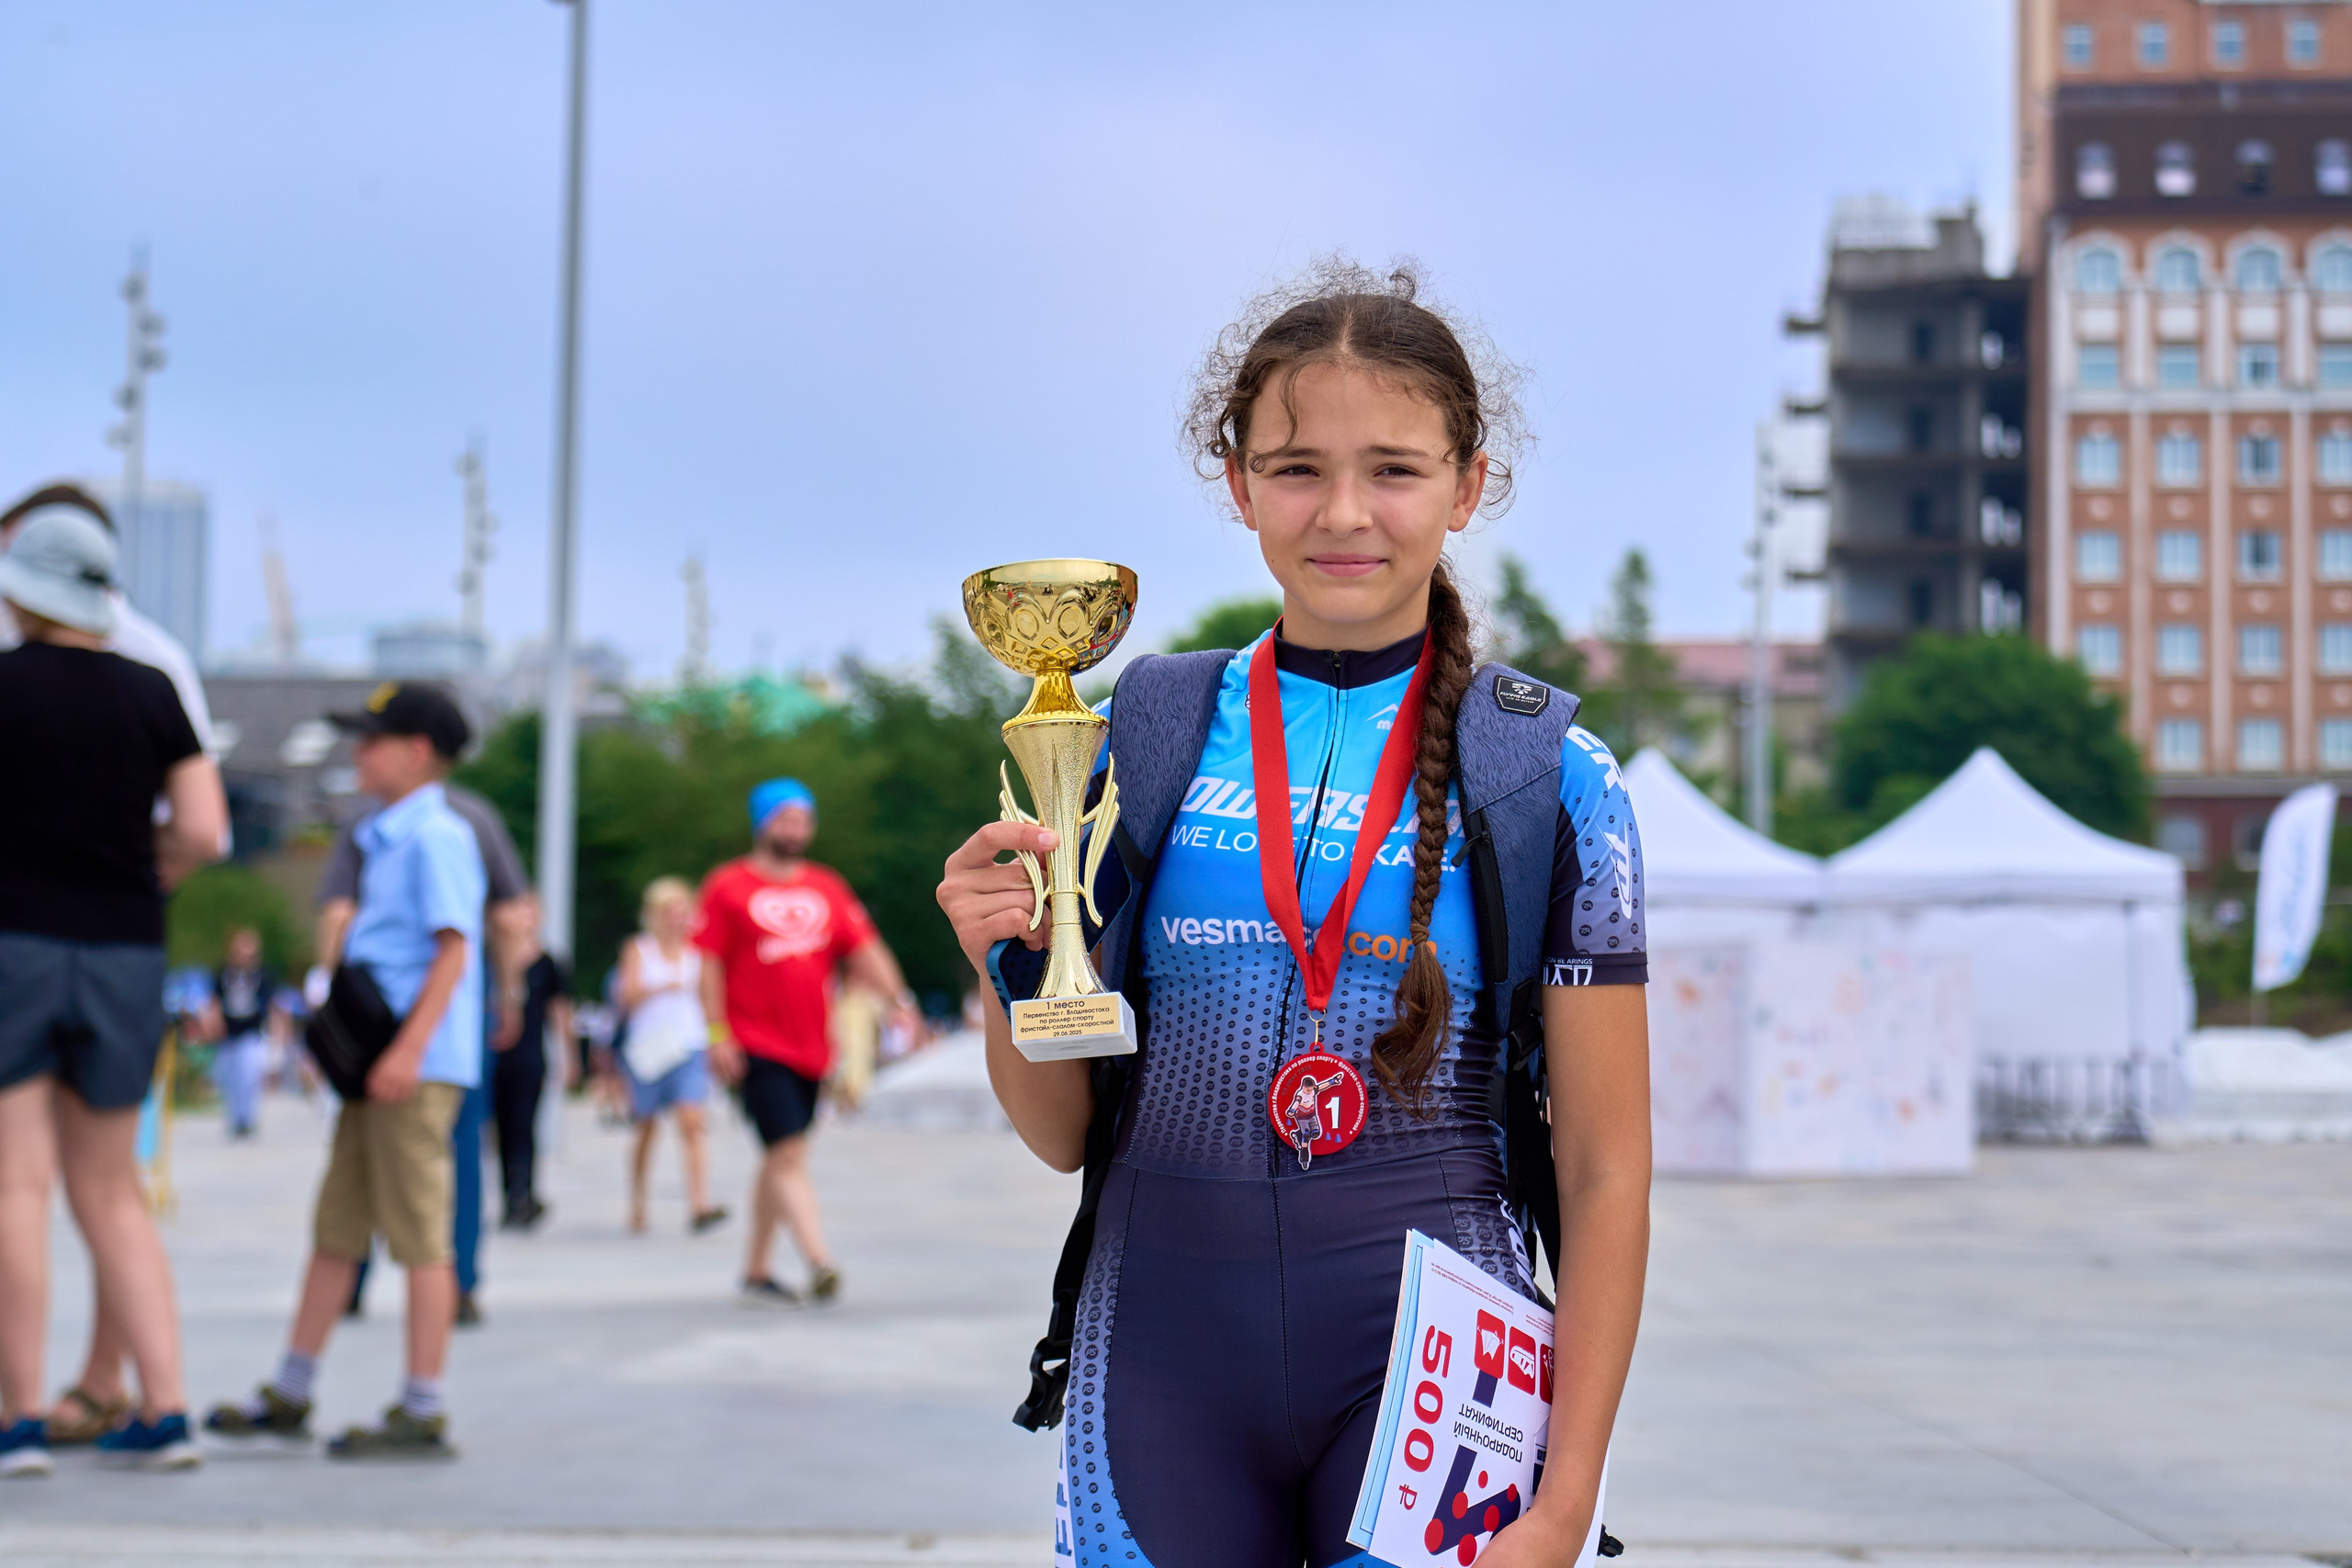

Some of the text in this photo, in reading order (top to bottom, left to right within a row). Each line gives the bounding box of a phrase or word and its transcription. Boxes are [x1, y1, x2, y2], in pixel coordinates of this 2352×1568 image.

[1171, 825, 1213, 847] WE
[1304, 836, 1345, 862] TO
[1160, 916, 1437, 964] vesma.com
[1046, 1000, 1085, 1010] 1 место
[1048, 1017, 1071, 1025] роллер
[1067, 1007, 1110, 1016] Владивостока
[1020, 1020, 1114, 1033] фристайл-слалом-скоростной
[1297, 1055, 1316, 1066] роллер
[1317, 1055, 1334, 1064] спорту
[1325, 1097, 1340, 1129] 1
[1404, 1325, 1453, 1472] 500
[1458, 1404, 1523, 1442] СЕРТИФИКАТ
[1453, 1421, 1522, 1463] ПОДАРОЧНЫЙ
